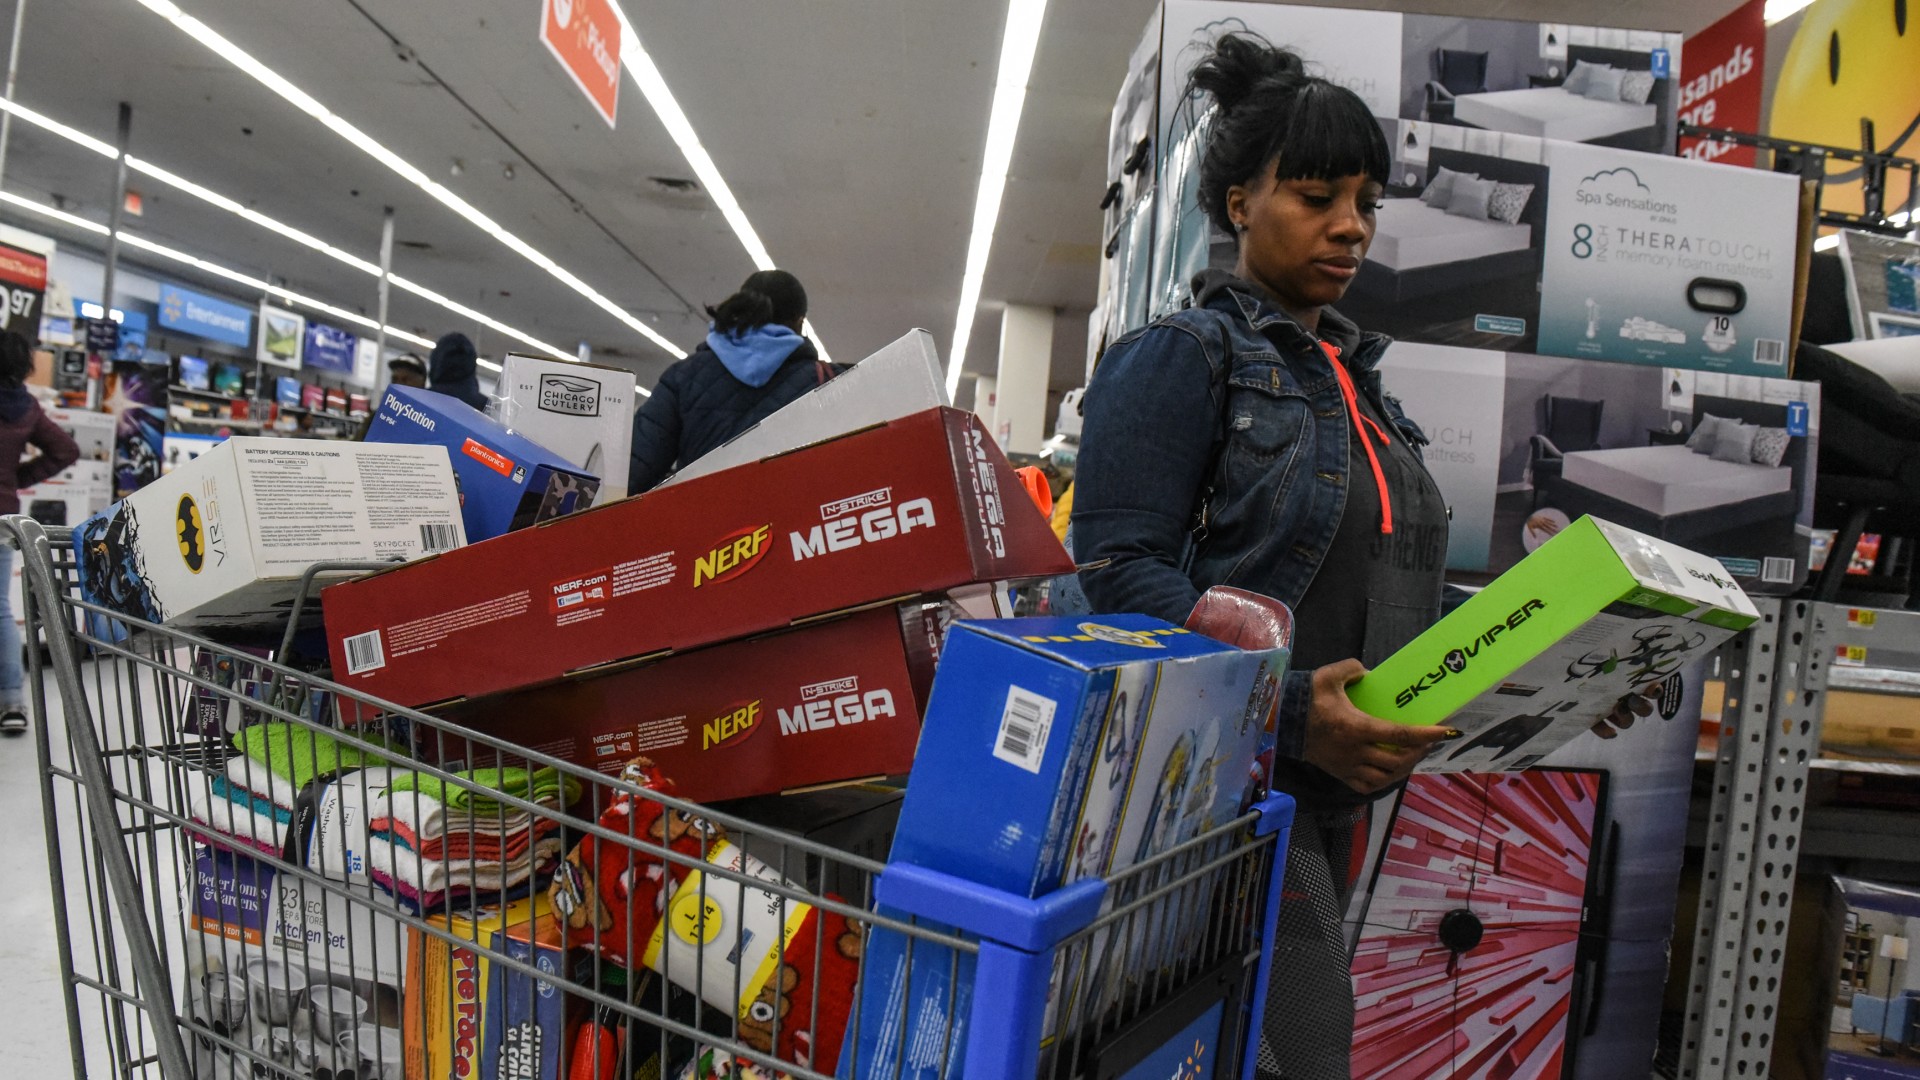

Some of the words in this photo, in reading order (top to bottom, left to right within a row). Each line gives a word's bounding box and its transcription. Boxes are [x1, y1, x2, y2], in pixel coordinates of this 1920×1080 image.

[1678, 44, 1753, 108] sands
[1679, 98, 1716, 127] ore
[1576, 189, 1602, 206] Spa
[1605, 192, 1678, 215] Sensations
[1571, 223, 1593, 259] 8
[1616, 247, 1673, 270] memory
[1677, 252, 1713, 272] foam
[1716, 259, 1773, 280] mattress
[186, 301, 246, 333] Entertainment
[1713, 316, 1730, 331] 10
[543, 398, 594, 412] CUTLERY
[544, 390, 595, 404] CHICAGO
[384, 393, 435, 431] PlayStation
[469, 445, 506, 469] plantronics
[1424, 449, 1476, 465] attress
[825, 491, 886, 516] N-STRIKE
[963, 431, 994, 560] ROTOFURY
[971, 429, 1006, 559] MEGA
[790, 497, 937, 562] MEGA
[373, 540, 416, 548] SKYROCKET
[693, 523, 772, 588] NERF
[553, 574, 608, 595] NERF.com
[1395, 664, 1447, 709] SKY
[1465, 598, 1546, 659] VIPER
[804, 679, 855, 697] N-STRIKE
[776, 688, 897, 736] MEGA
[592, 730, 634, 744] NERF.com
[702, 699, 762, 751] NERF
[352, 855, 362, 872] 18
[198, 871, 230, 891] Beter
[203, 886, 214, 900] &
[278, 886, 299, 909] 23
[203, 920, 226, 933] LIMITD
[227, 927, 252, 939] EDITON
[276, 908, 293, 920] PEP
[303, 914, 324, 927] TORE
[275, 919, 322, 944] Ktchen
[454, 1001, 483, 1077] Face
